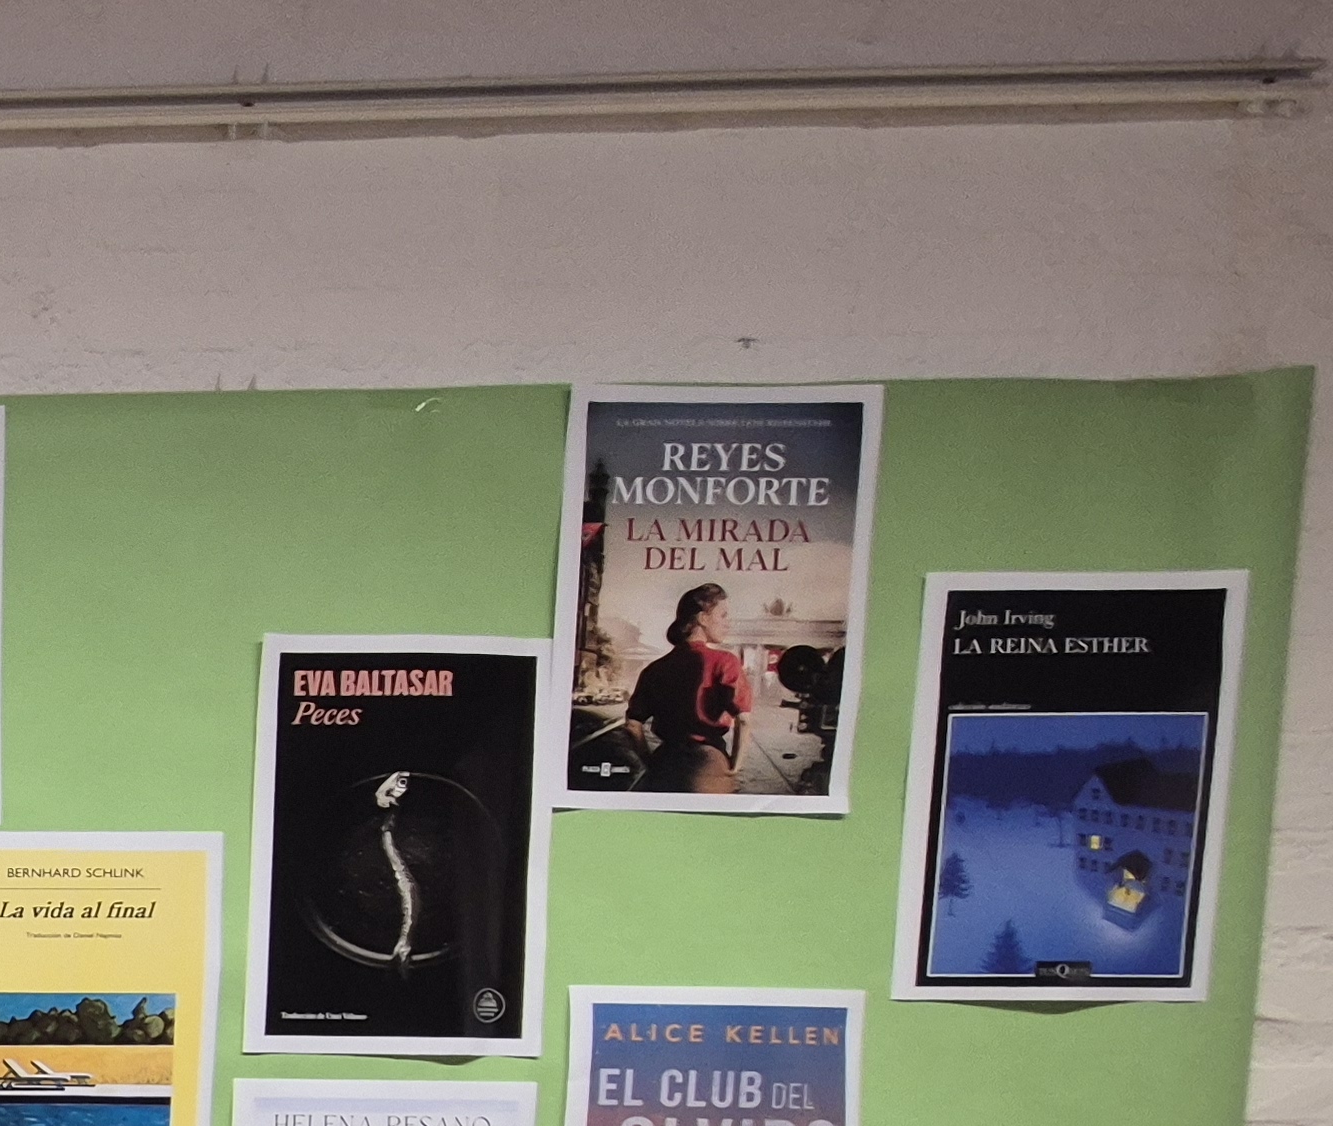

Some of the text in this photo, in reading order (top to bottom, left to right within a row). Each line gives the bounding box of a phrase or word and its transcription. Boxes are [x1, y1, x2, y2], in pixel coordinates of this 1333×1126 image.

[662, 442, 786, 472] REYES
[612, 476, 830, 506] MONFORTE
[627, 518, 811, 543] LA MIRADA
[644, 547, 789, 571] DEL MAL
[953, 610, 1055, 630] John Irving
[953, 637, 1150, 655] LA REINA ESTHER
[293, 669, 453, 697] EVA BALTASAR
[291, 701, 362, 725] Peces
[7, 868, 144, 878] BERNHARD SCHLINK
[33, 901, 74, 919] vida
[81, 901, 102, 919] al
[106, 901, 156, 919] final
[604, 1023, 840, 1046] ALICE KELLEN
[597, 1068, 815, 1110] EL CLUB DEL
